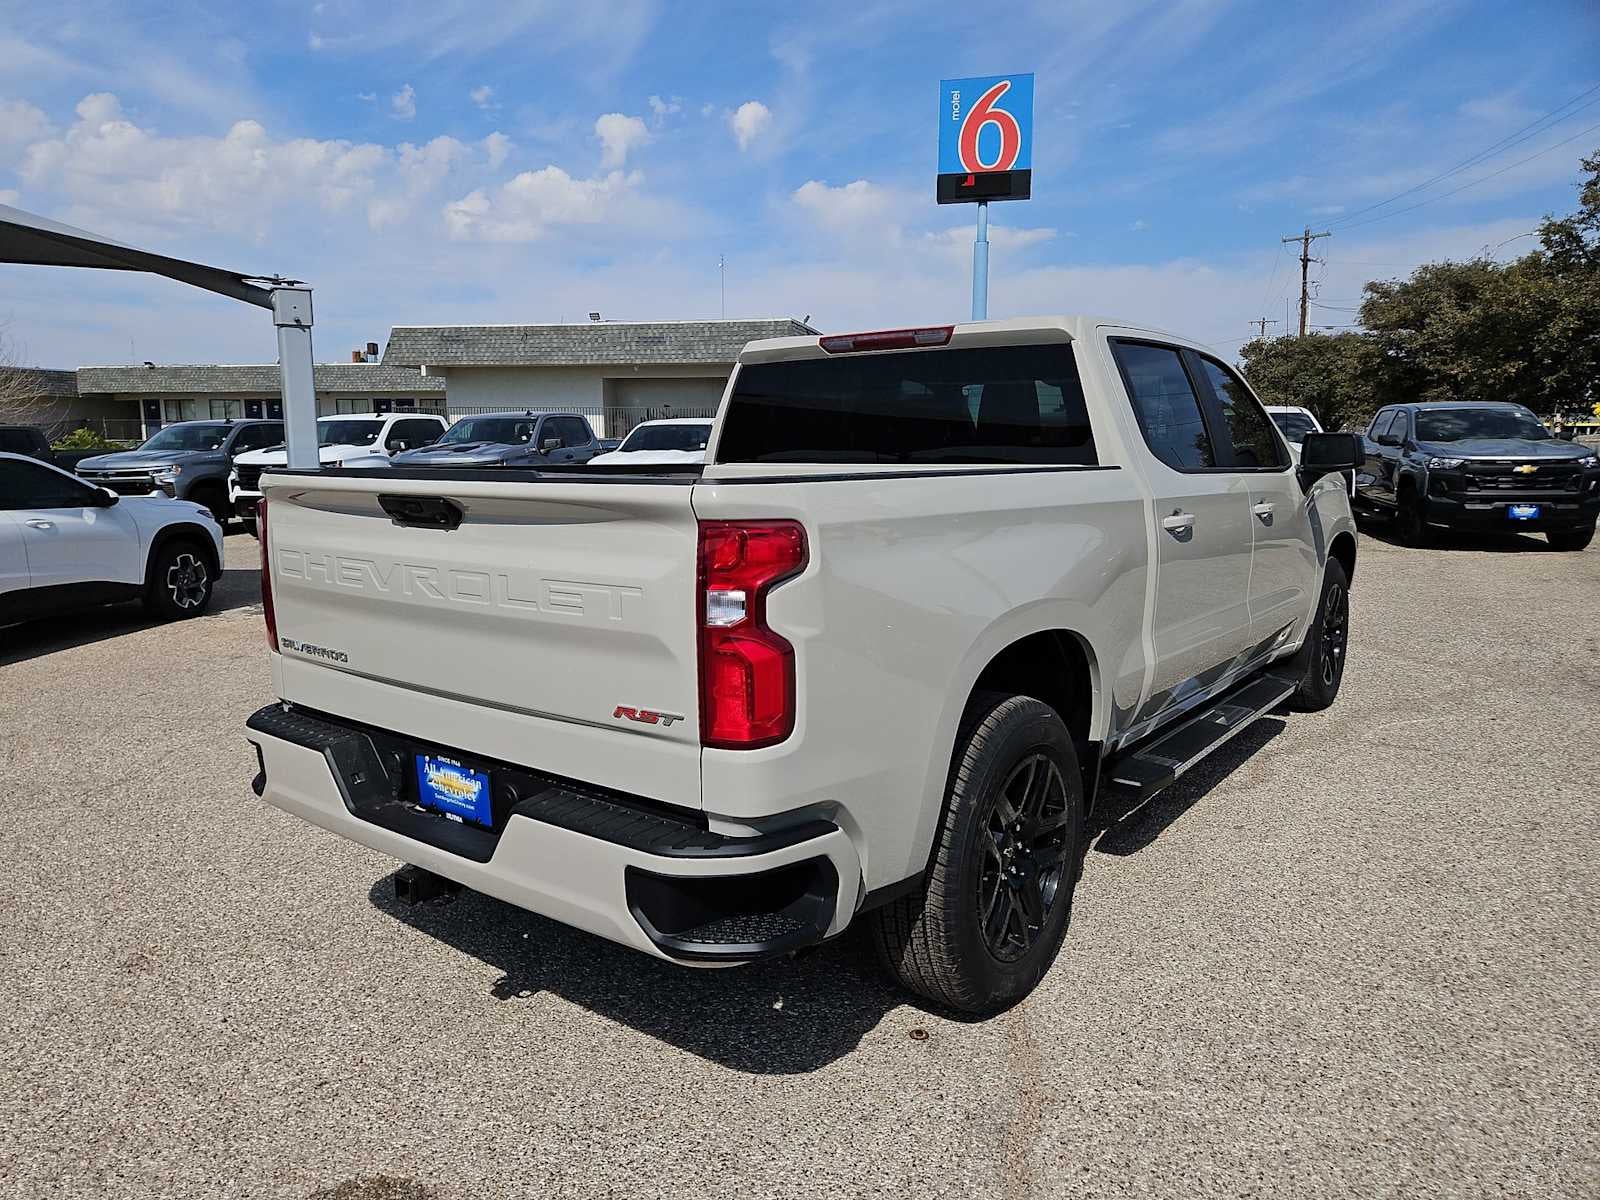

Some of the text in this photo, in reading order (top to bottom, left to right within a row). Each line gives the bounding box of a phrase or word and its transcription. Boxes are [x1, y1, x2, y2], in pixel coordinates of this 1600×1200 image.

[951, 90, 960, 121] motel
[957, 79, 1022, 173] 6
[278, 548, 648, 622] CHEVROLET
[280, 637, 348, 663] SILVERADO
[612, 705, 685, 727] RST
[424, 762, 482, 790] All American
[432, 778, 477, 802] Chevrolet
